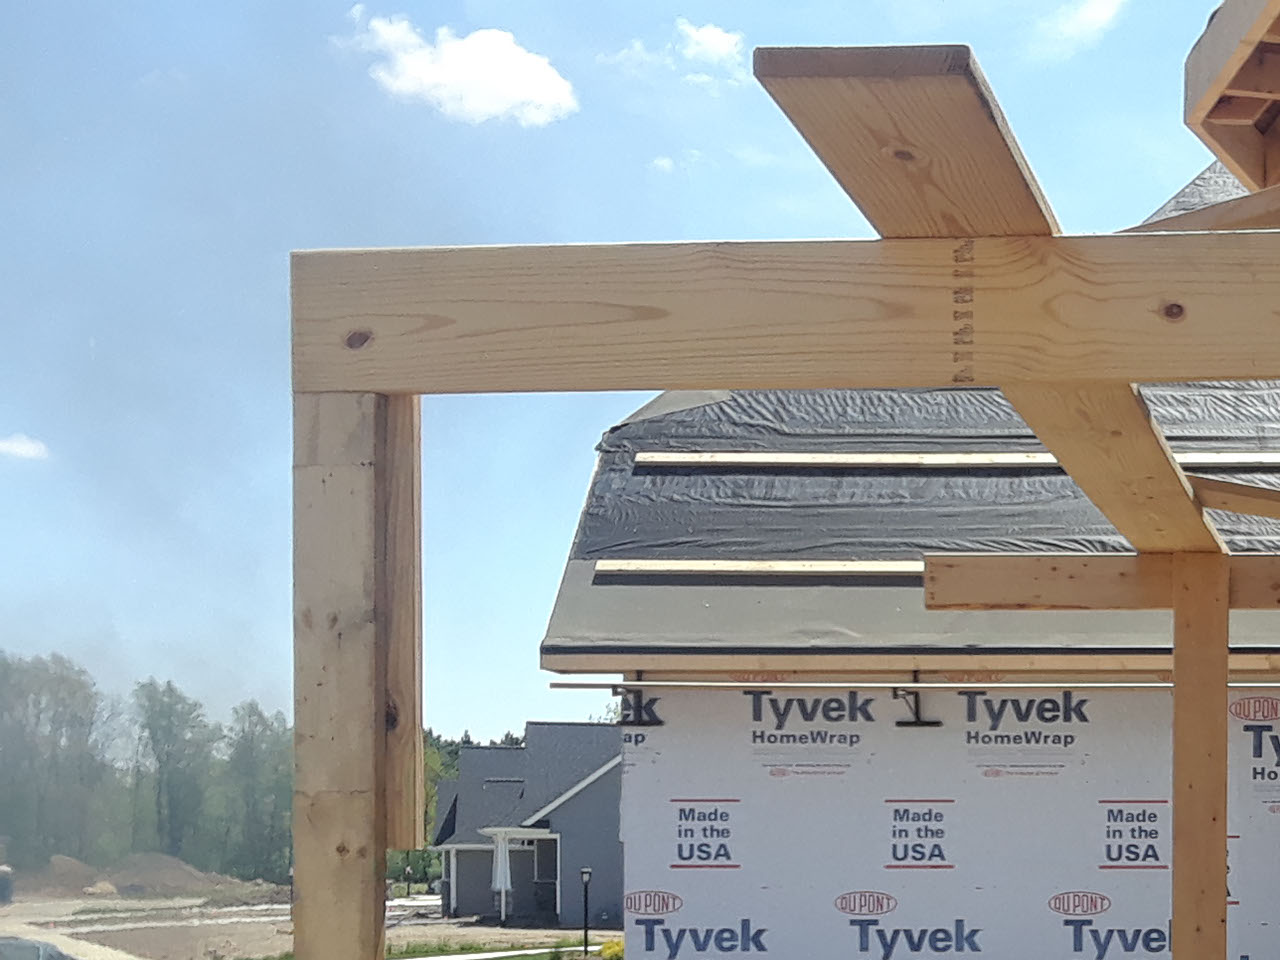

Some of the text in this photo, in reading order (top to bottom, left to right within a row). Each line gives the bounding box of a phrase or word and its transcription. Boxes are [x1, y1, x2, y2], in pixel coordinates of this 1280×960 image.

[743, 690, 875, 730] Tyvek
[958, 690, 1089, 730] Tyvek
[752, 731, 861, 746] HomeWrap
[966, 731, 1075, 746] HomeWrap
[678, 808, 729, 822] Made
[892, 809, 944, 823] Made
[1107, 810, 1158, 824] Made
[678, 826, 730, 839] in the
[892, 826, 944, 840] in the
[1106, 827, 1158, 840] in the
[677, 843, 732, 861] USA
[891, 844, 946, 862] USA
[1105, 844, 1160, 862] USA
[635, 919, 768, 960] Tyvek
[850, 919, 982, 960] Tyvek
